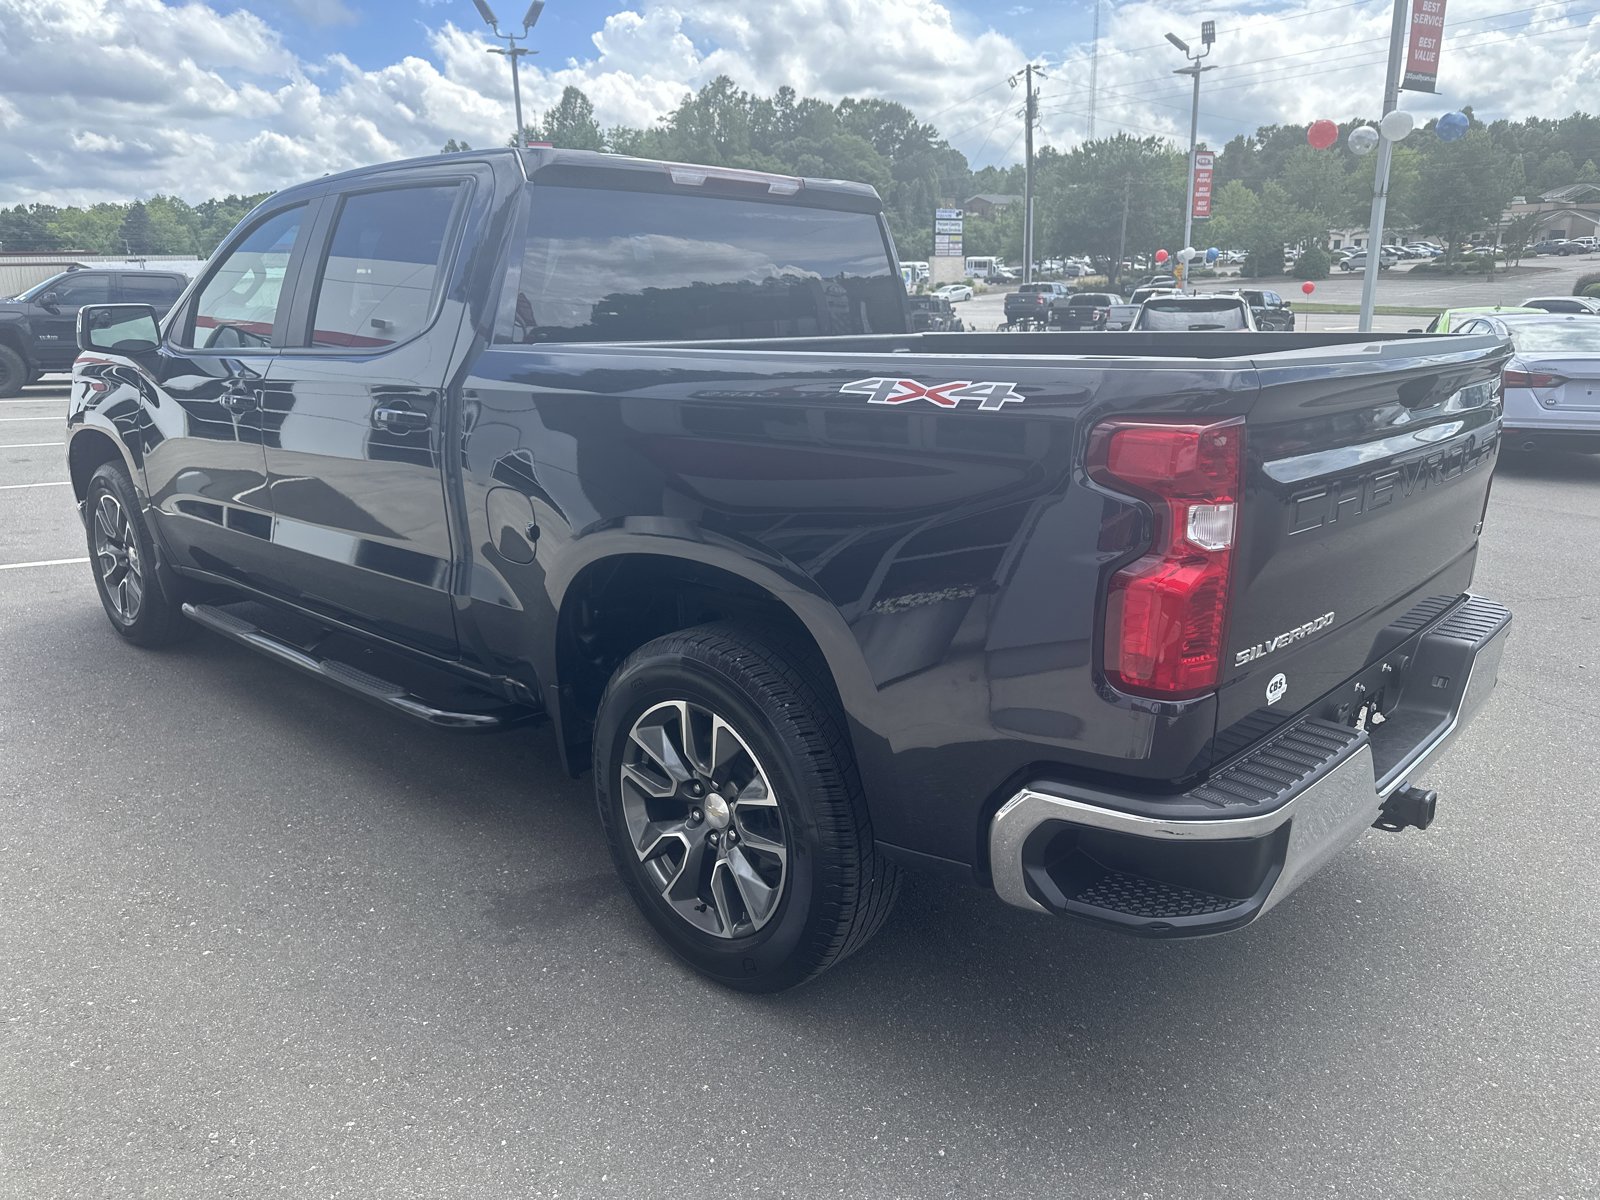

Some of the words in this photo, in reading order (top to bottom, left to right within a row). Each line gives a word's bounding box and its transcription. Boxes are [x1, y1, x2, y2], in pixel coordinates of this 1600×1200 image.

[1423, 0, 1441, 12] BEST
[1413, 14, 1443, 27] SERVICE
[1418, 36, 1436, 48] BEST
[1414, 50, 1435, 62] VALUE
[1288, 431, 1497, 536] CHEVROLET
[1234, 611, 1335, 668] SILVERADO
[1269, 678, 1283, 694] CBS
